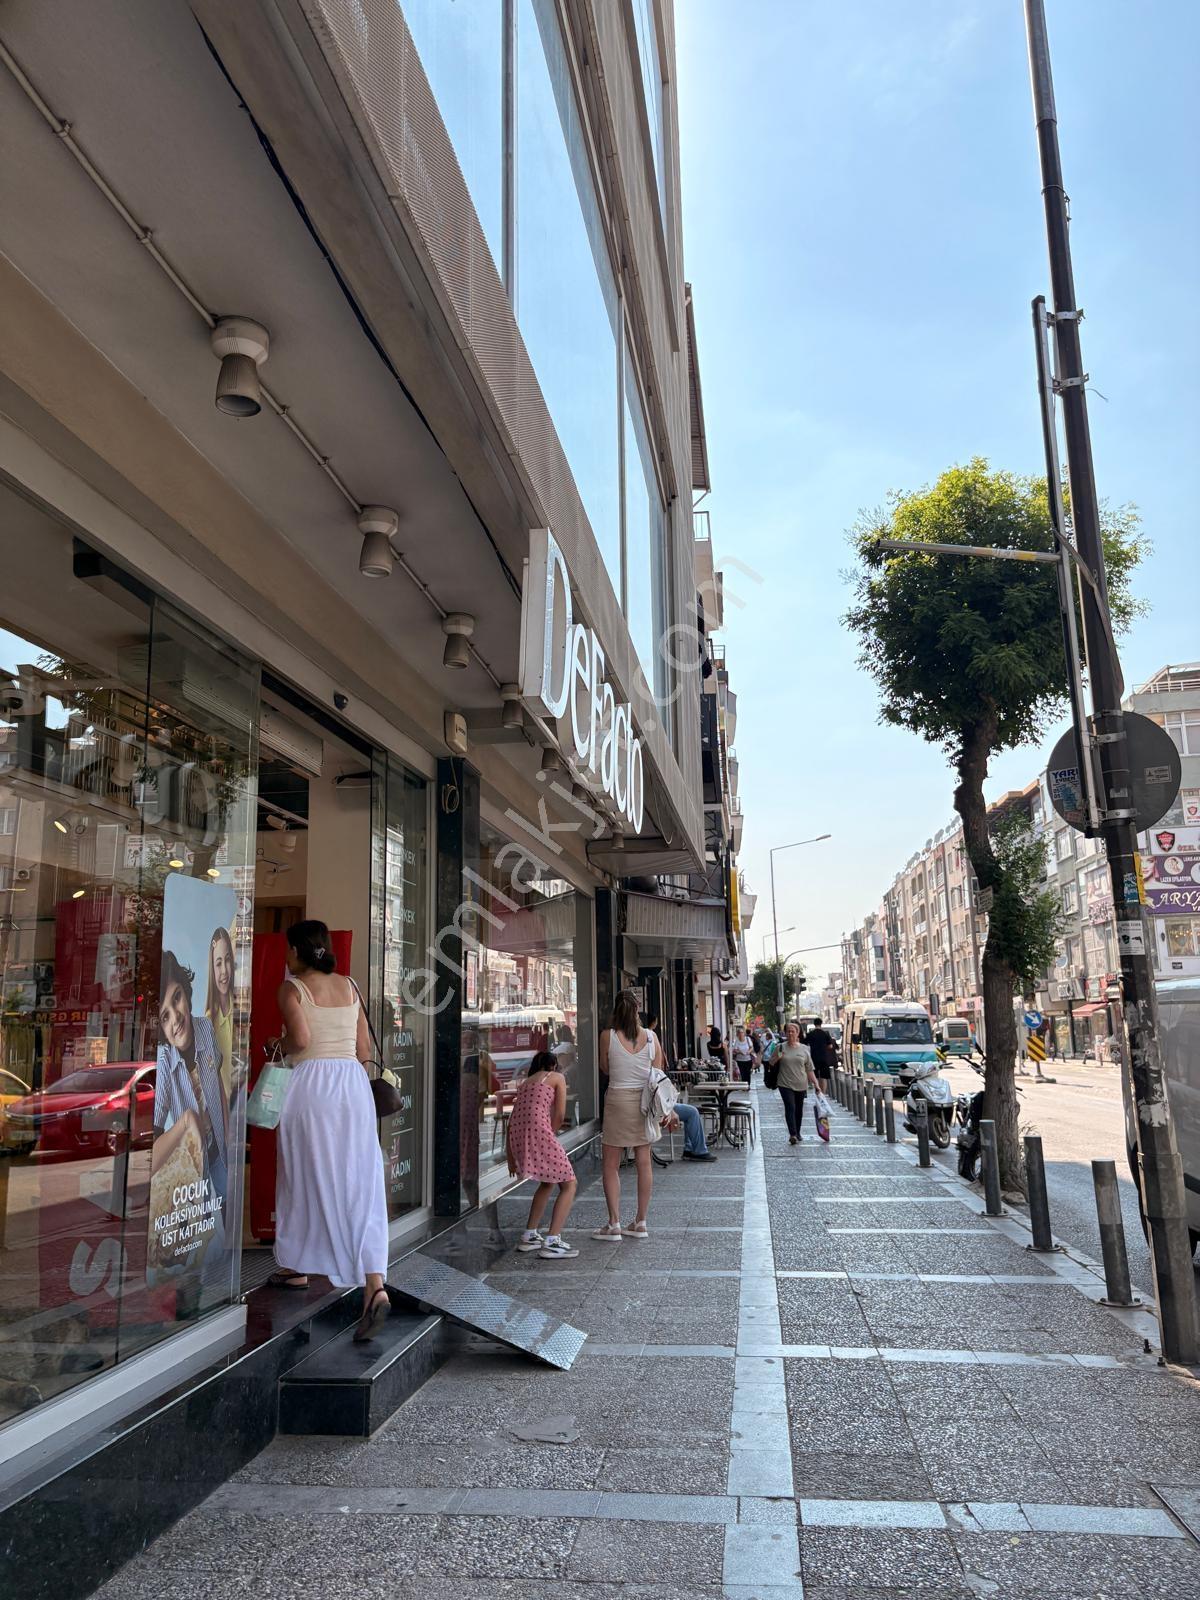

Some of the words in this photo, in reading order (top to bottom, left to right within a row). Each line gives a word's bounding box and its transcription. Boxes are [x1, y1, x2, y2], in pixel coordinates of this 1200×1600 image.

[541, 526, 644, 835] DeFacto
[393, 1031, 413, 1047] KADIN
[390, 1158, 411, 1180] KADIN
[173, 1178, 209, 1211] ÇOCUK
[154, 1196, 223, 1232] KOLEKSİYONUMUZ
[162, 1229, 178, 1247] ÜST
[179, 1217, 215, 1241] KATTADIR
[174, 1240, 203, 1257] defacto.com
